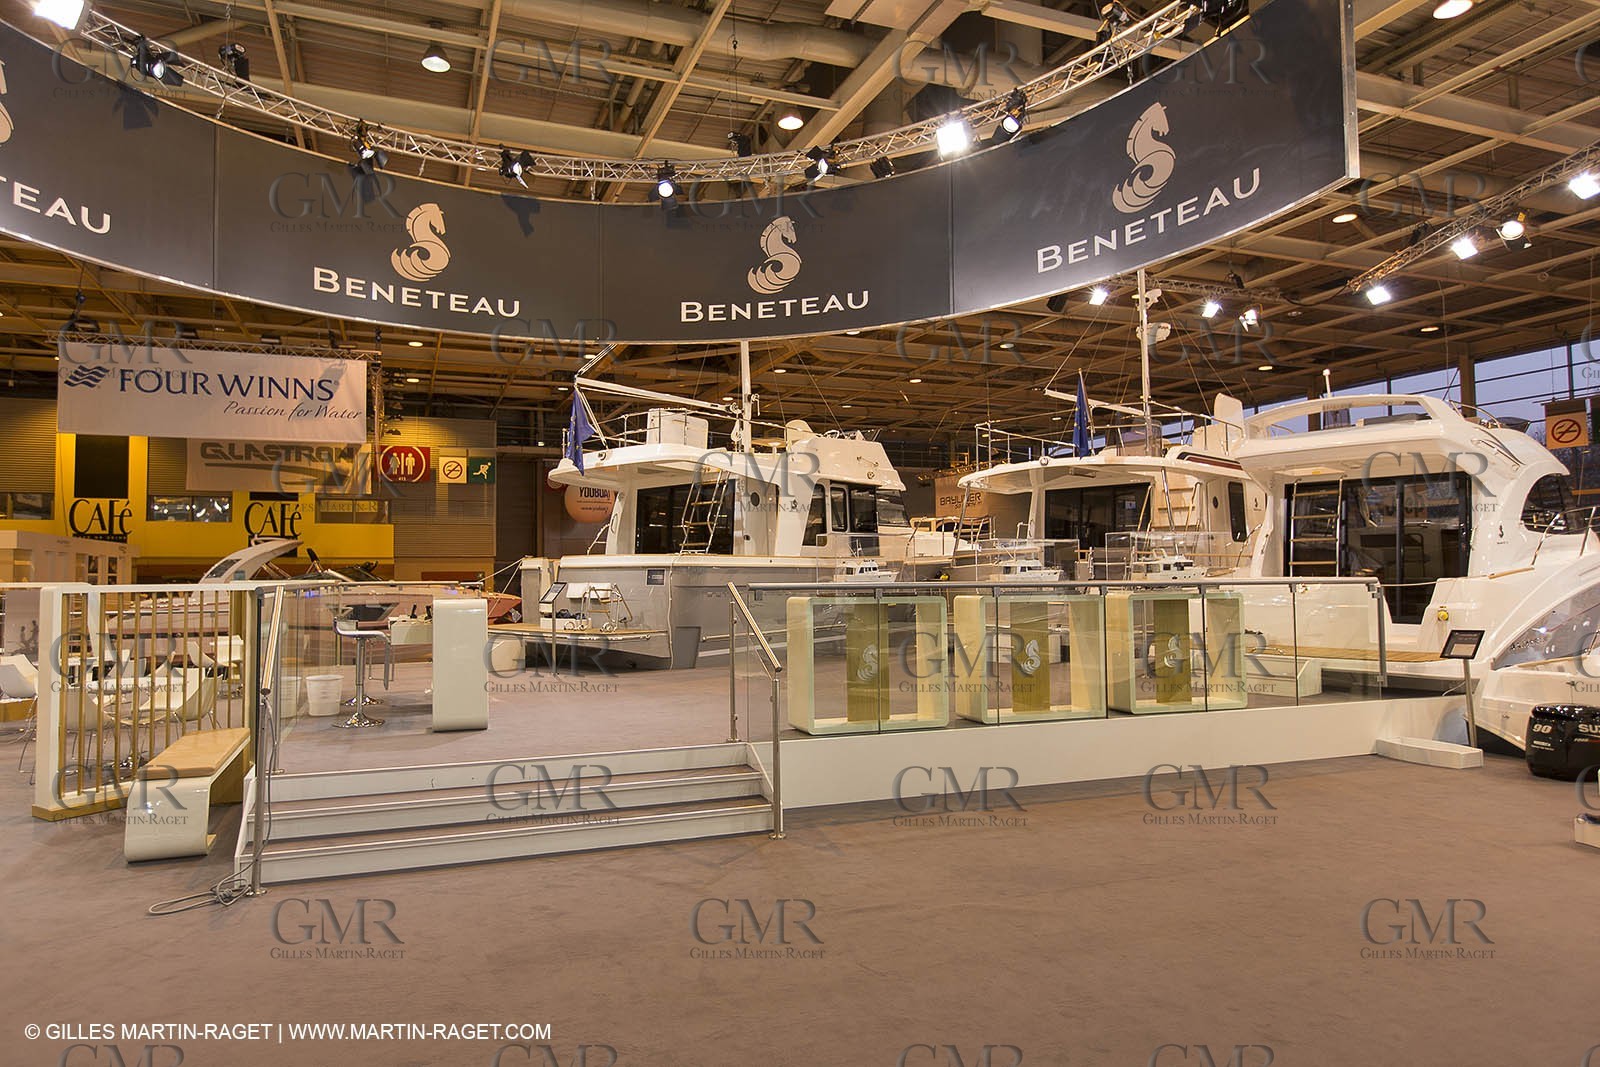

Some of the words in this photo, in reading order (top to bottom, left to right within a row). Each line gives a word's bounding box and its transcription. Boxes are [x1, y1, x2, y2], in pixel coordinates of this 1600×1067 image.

[1037, 168, 1260, 273] BENETEAU
[314, 267, 520, 318] BENETEAU
[681, 291, 869, 323] BENETEAU
[120, 369, 212, 395] FOUR
[224, 401, 286, 416] Passion
[288, 402, 313, 421] for
[314, 405, 362, 419] Water
[201, 442, 357, 463] GLASTRON
